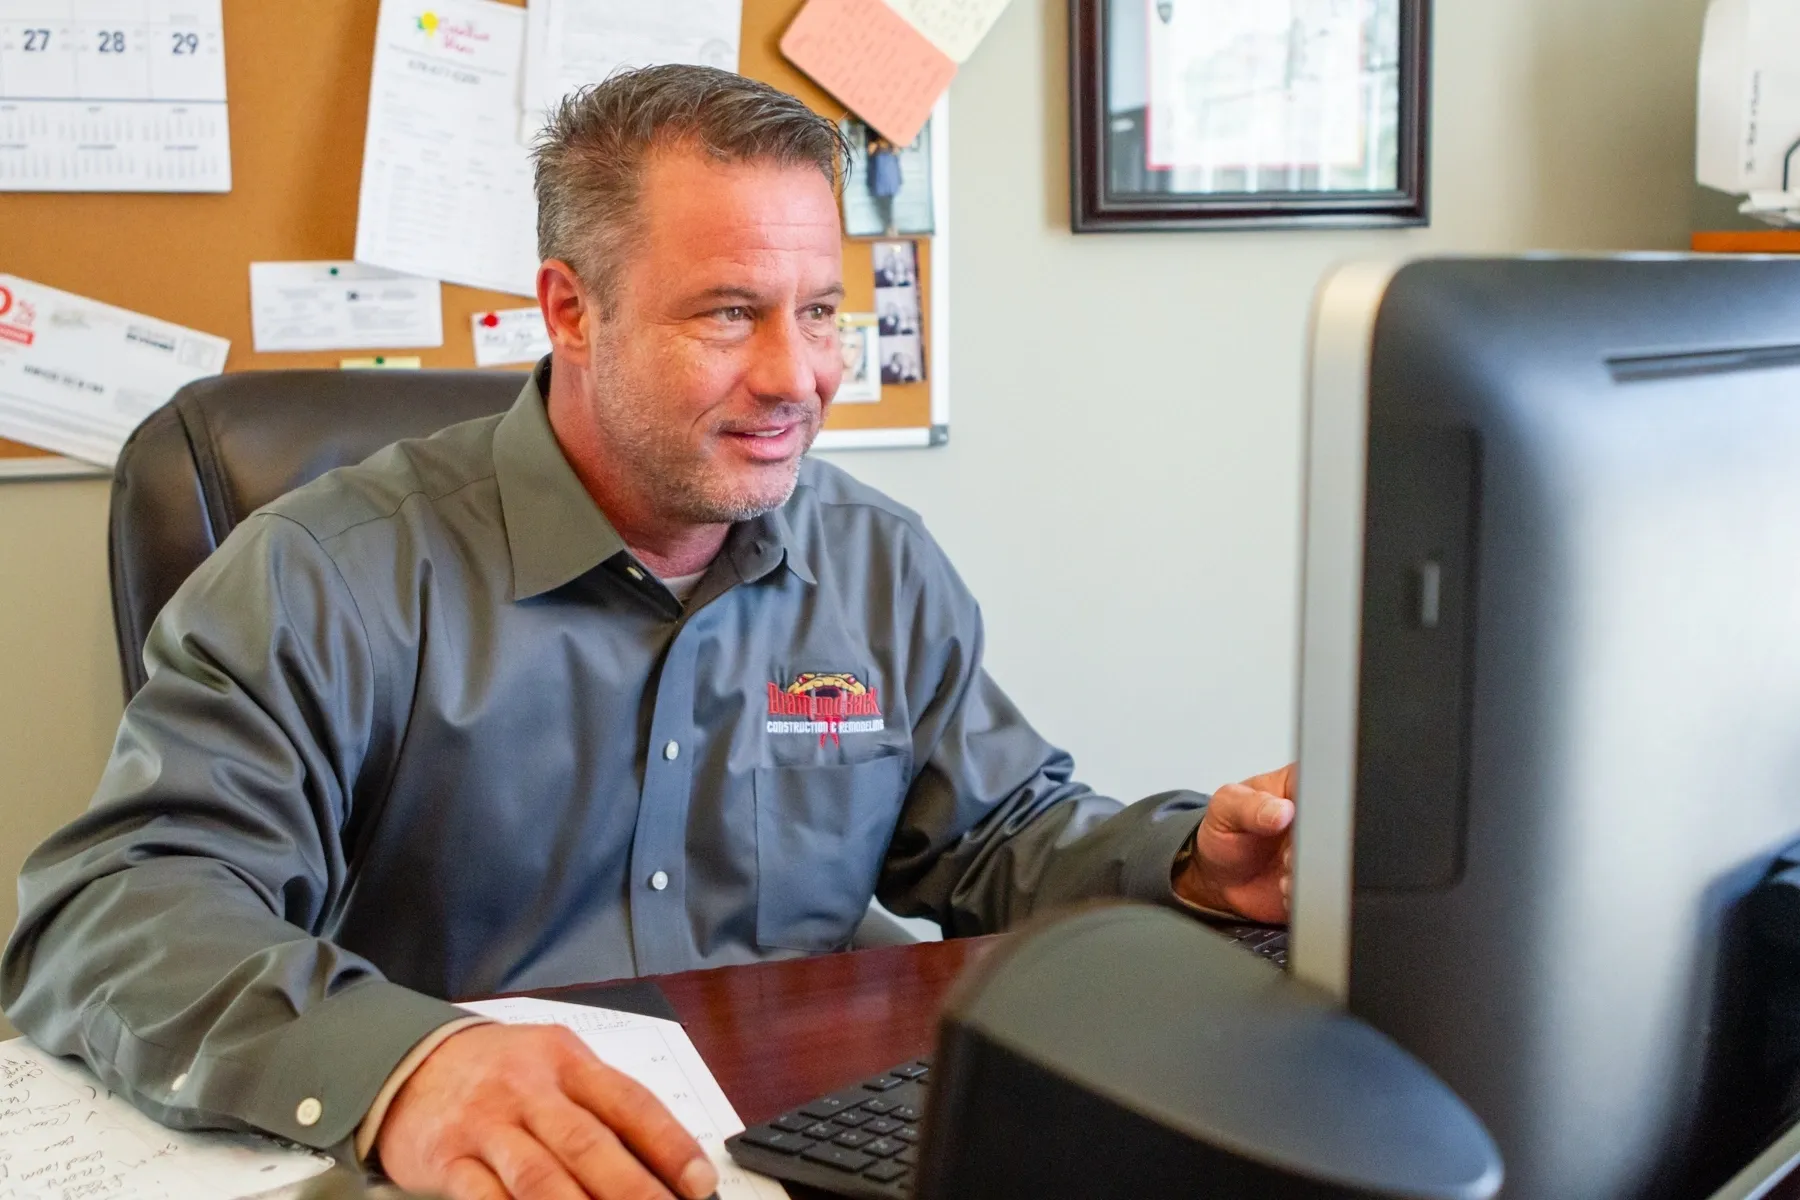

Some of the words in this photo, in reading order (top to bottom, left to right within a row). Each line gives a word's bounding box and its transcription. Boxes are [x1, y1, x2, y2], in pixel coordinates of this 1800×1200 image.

[23, 28, 51, 51] 27
[98, 30, 126, 53] 28
[171, 32, 199, 55] 29
[767, 721, 828, 733] CONSTRUCTION
[838, 718, 884, 733] REMODELING
